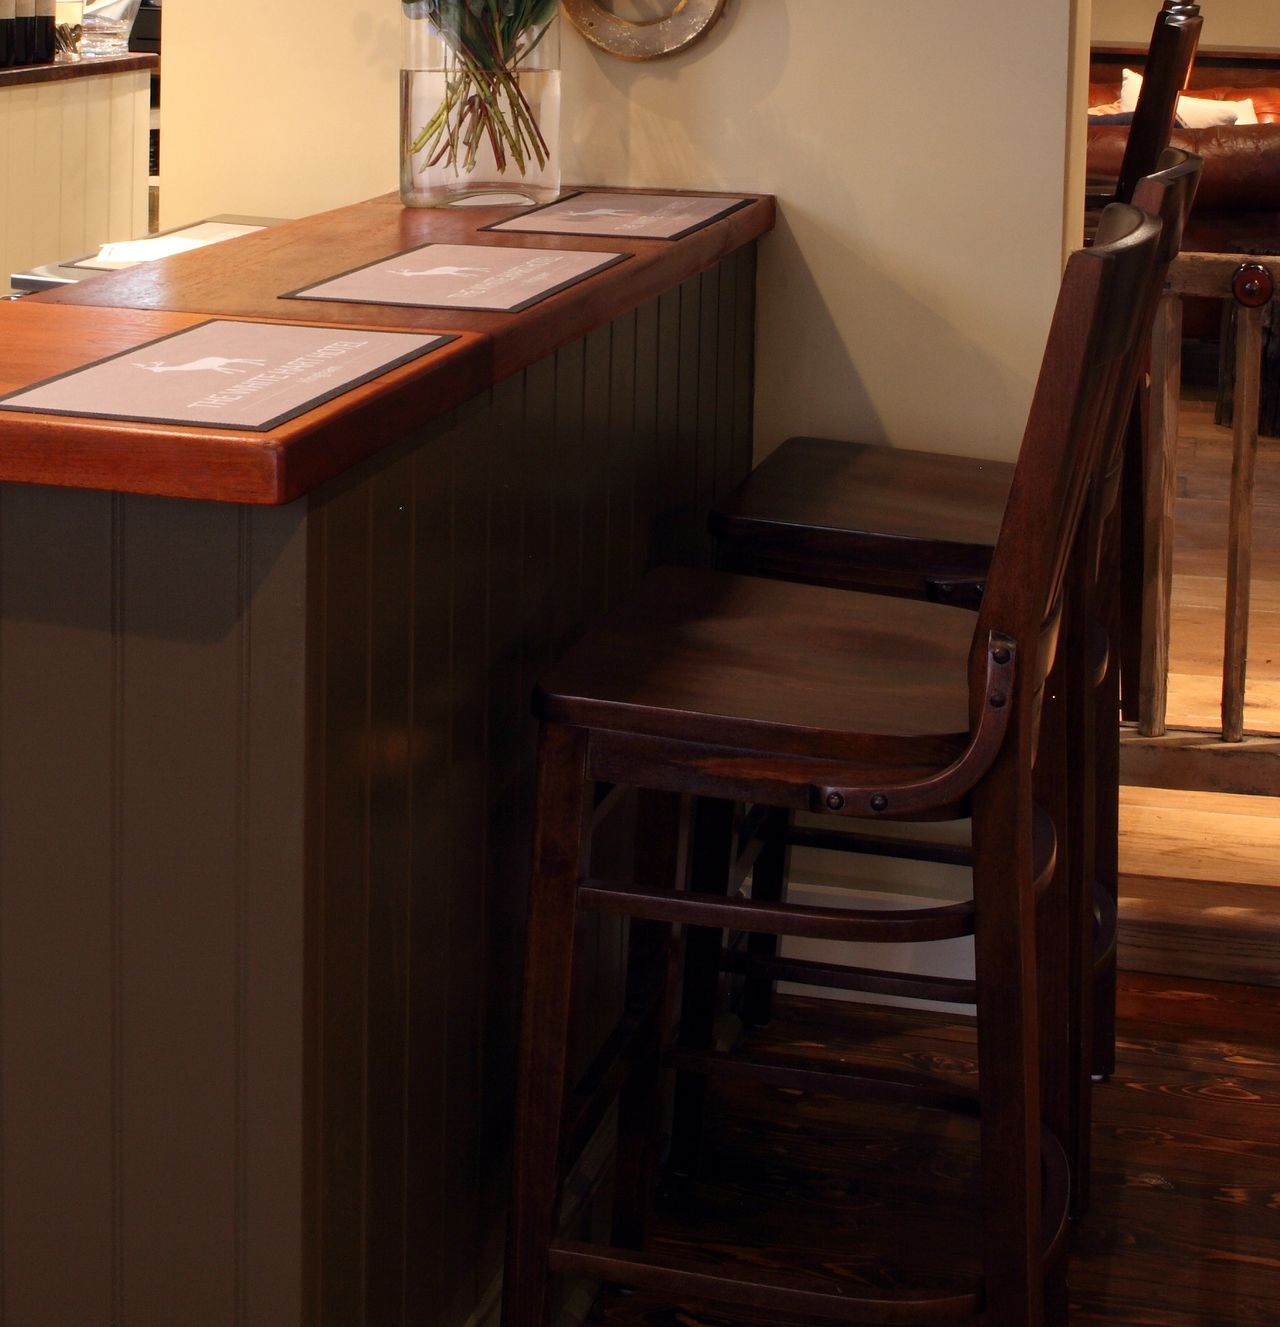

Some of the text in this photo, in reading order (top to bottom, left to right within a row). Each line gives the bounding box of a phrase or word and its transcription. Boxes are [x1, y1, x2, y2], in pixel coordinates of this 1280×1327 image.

[186, 340, 369, 408] THE WHITE HART HOTEL
